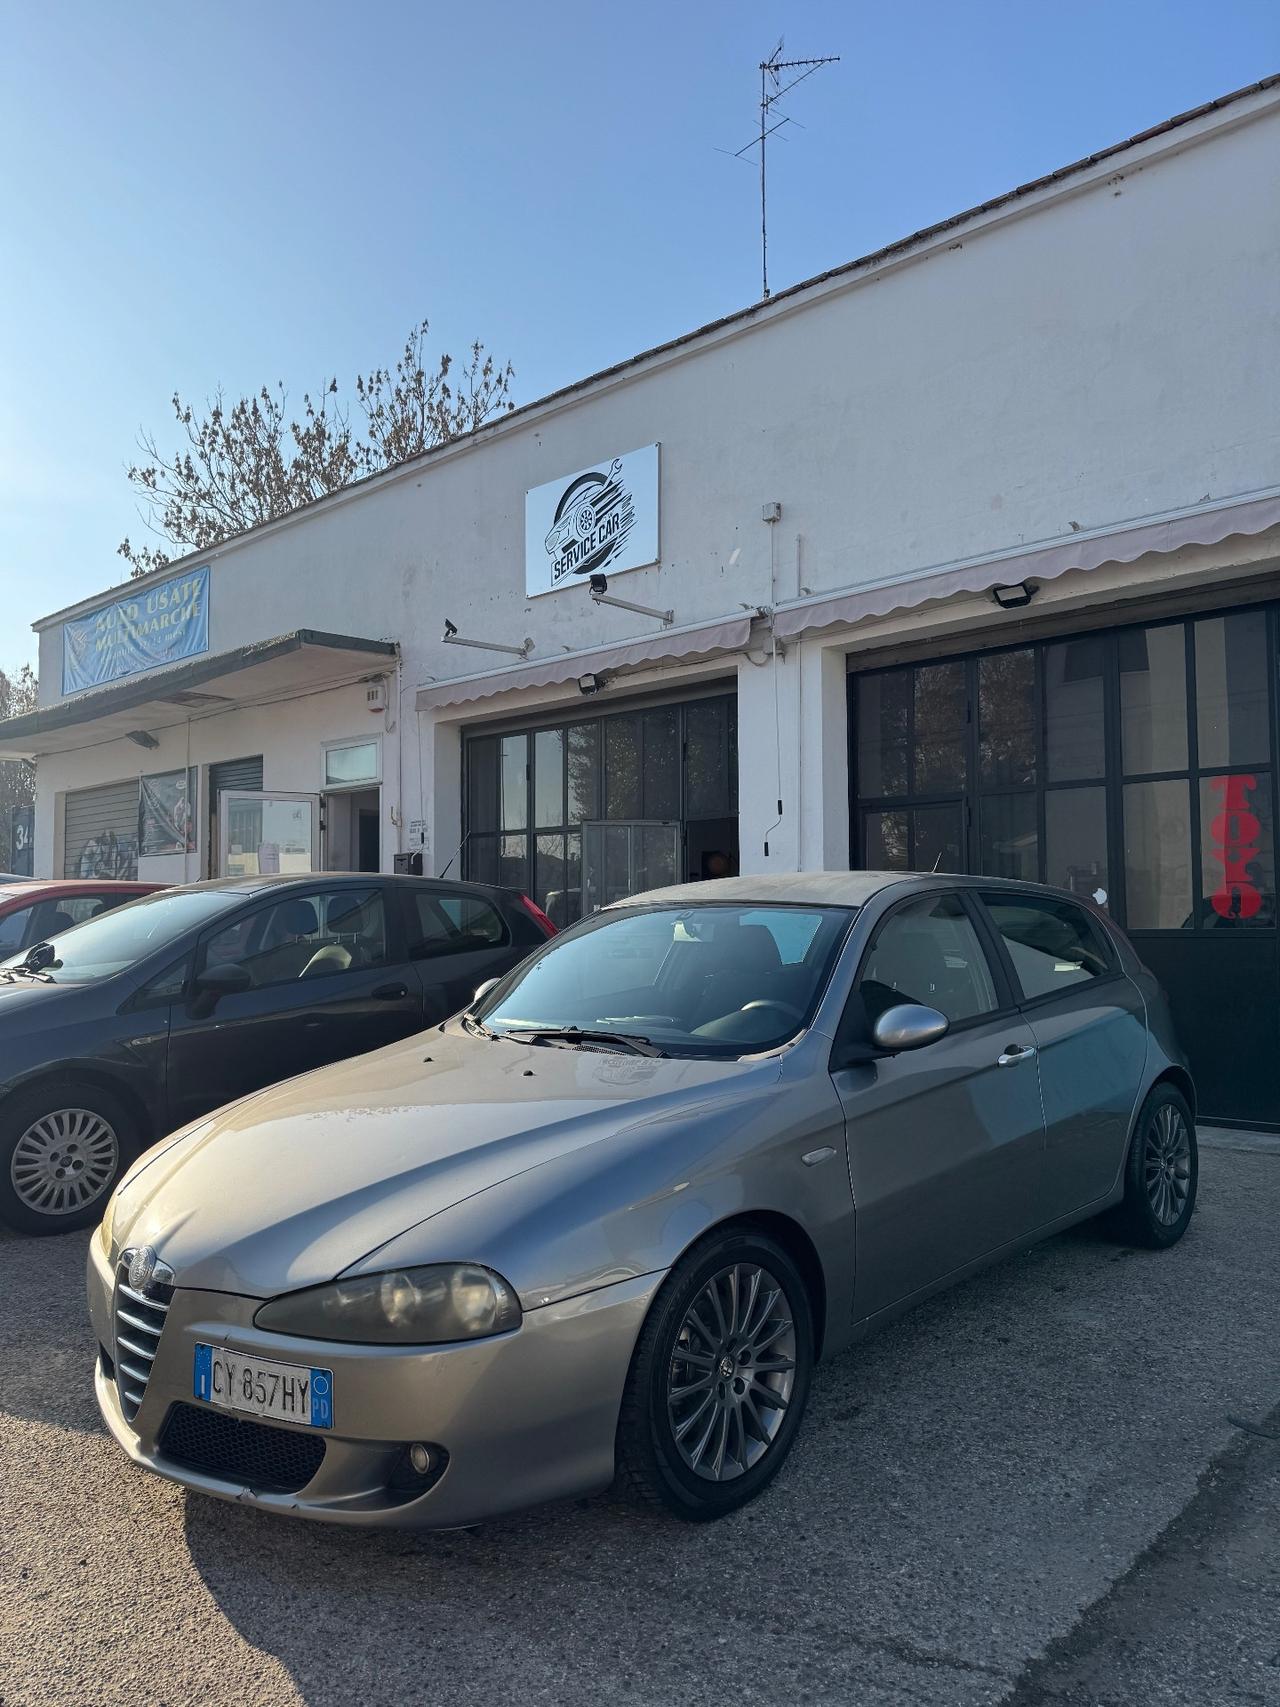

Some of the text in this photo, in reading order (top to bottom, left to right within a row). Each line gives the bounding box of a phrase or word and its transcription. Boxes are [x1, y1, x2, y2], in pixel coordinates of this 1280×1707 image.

[554, 512, 621, 580] SERVICE CAR
[96, 579, 201, 632] AUTO USATE
[312, 1397, 330, 1419] PD
